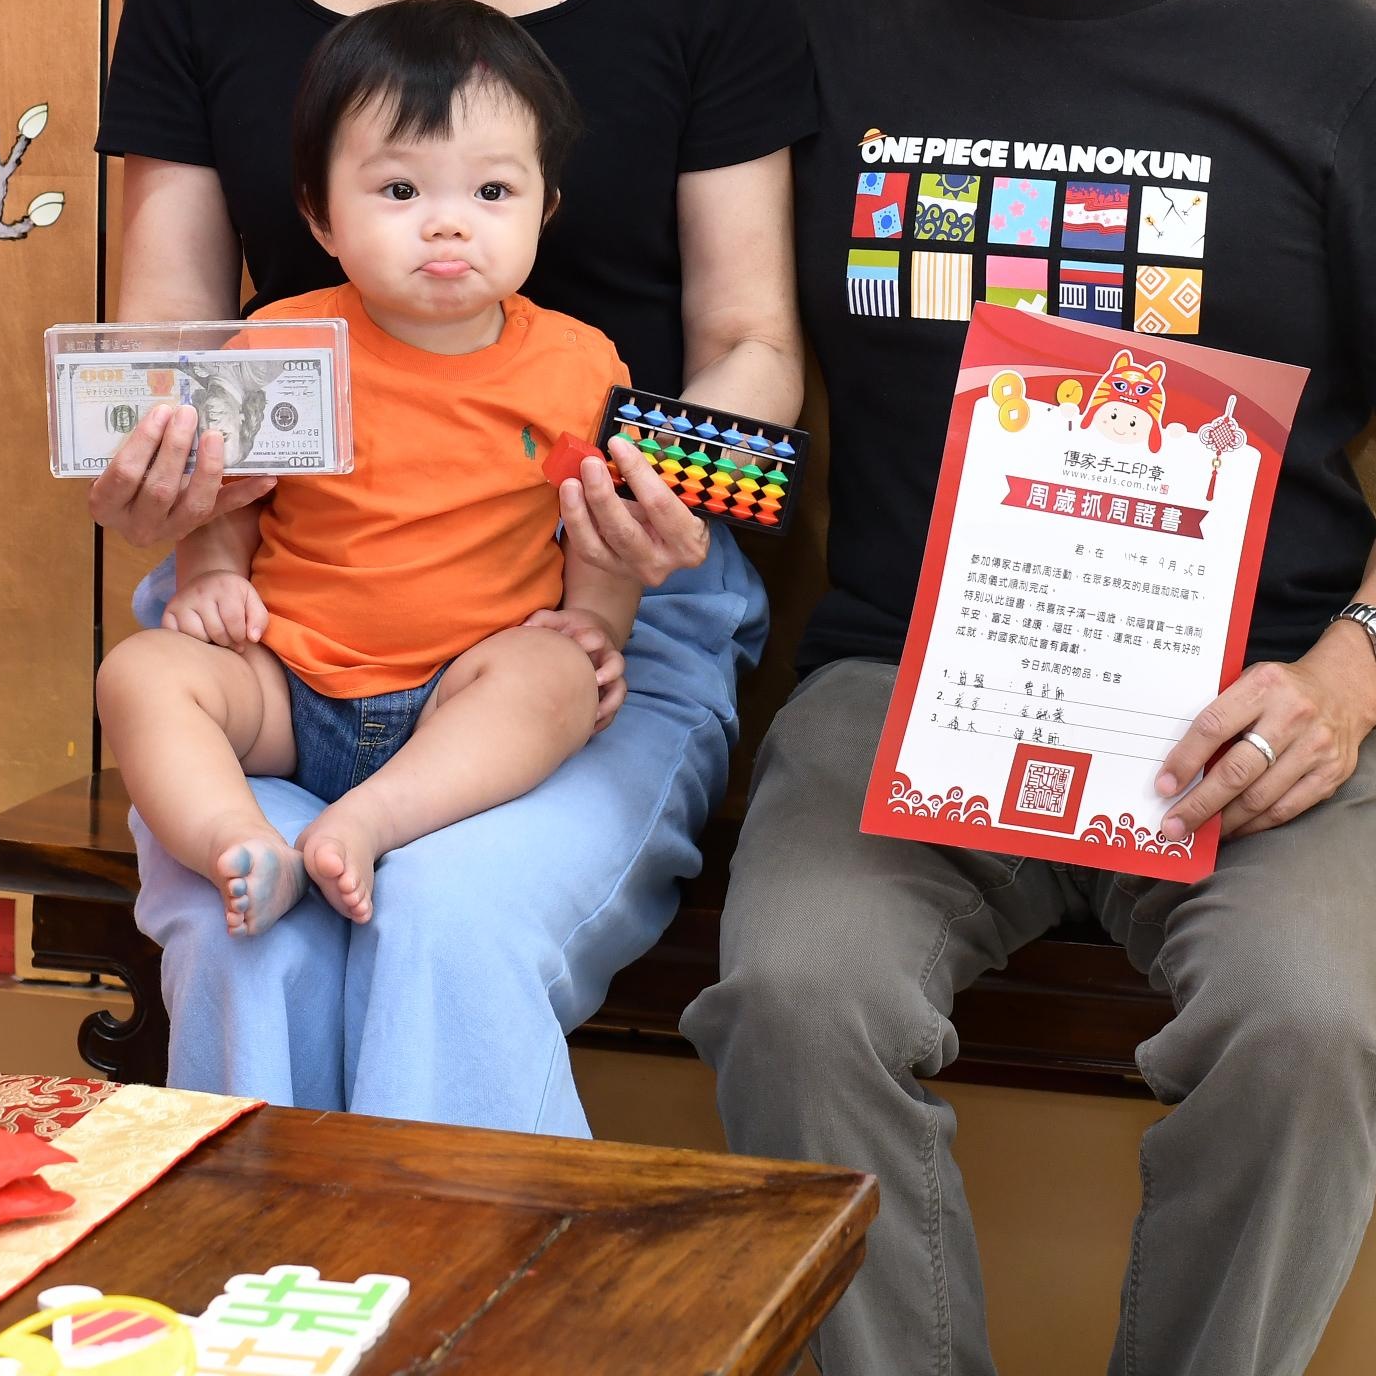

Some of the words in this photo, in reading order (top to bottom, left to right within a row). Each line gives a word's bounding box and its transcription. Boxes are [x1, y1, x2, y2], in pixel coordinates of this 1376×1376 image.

[860, 135, 924, 165] ONE
[922, 137, 1010, 169] PIECE
[1013, 140, 1213, 184] WANOKUNI
[283, 360, 319, 371] 100
[288, 456, 322, 467] 100
[1063, 449, 1165, 482] 傳家手工印章
[1062, 468, 1159, 492] www.seals.com.tw
[1025, 482, 1183, 532] 周歲抓周證書
